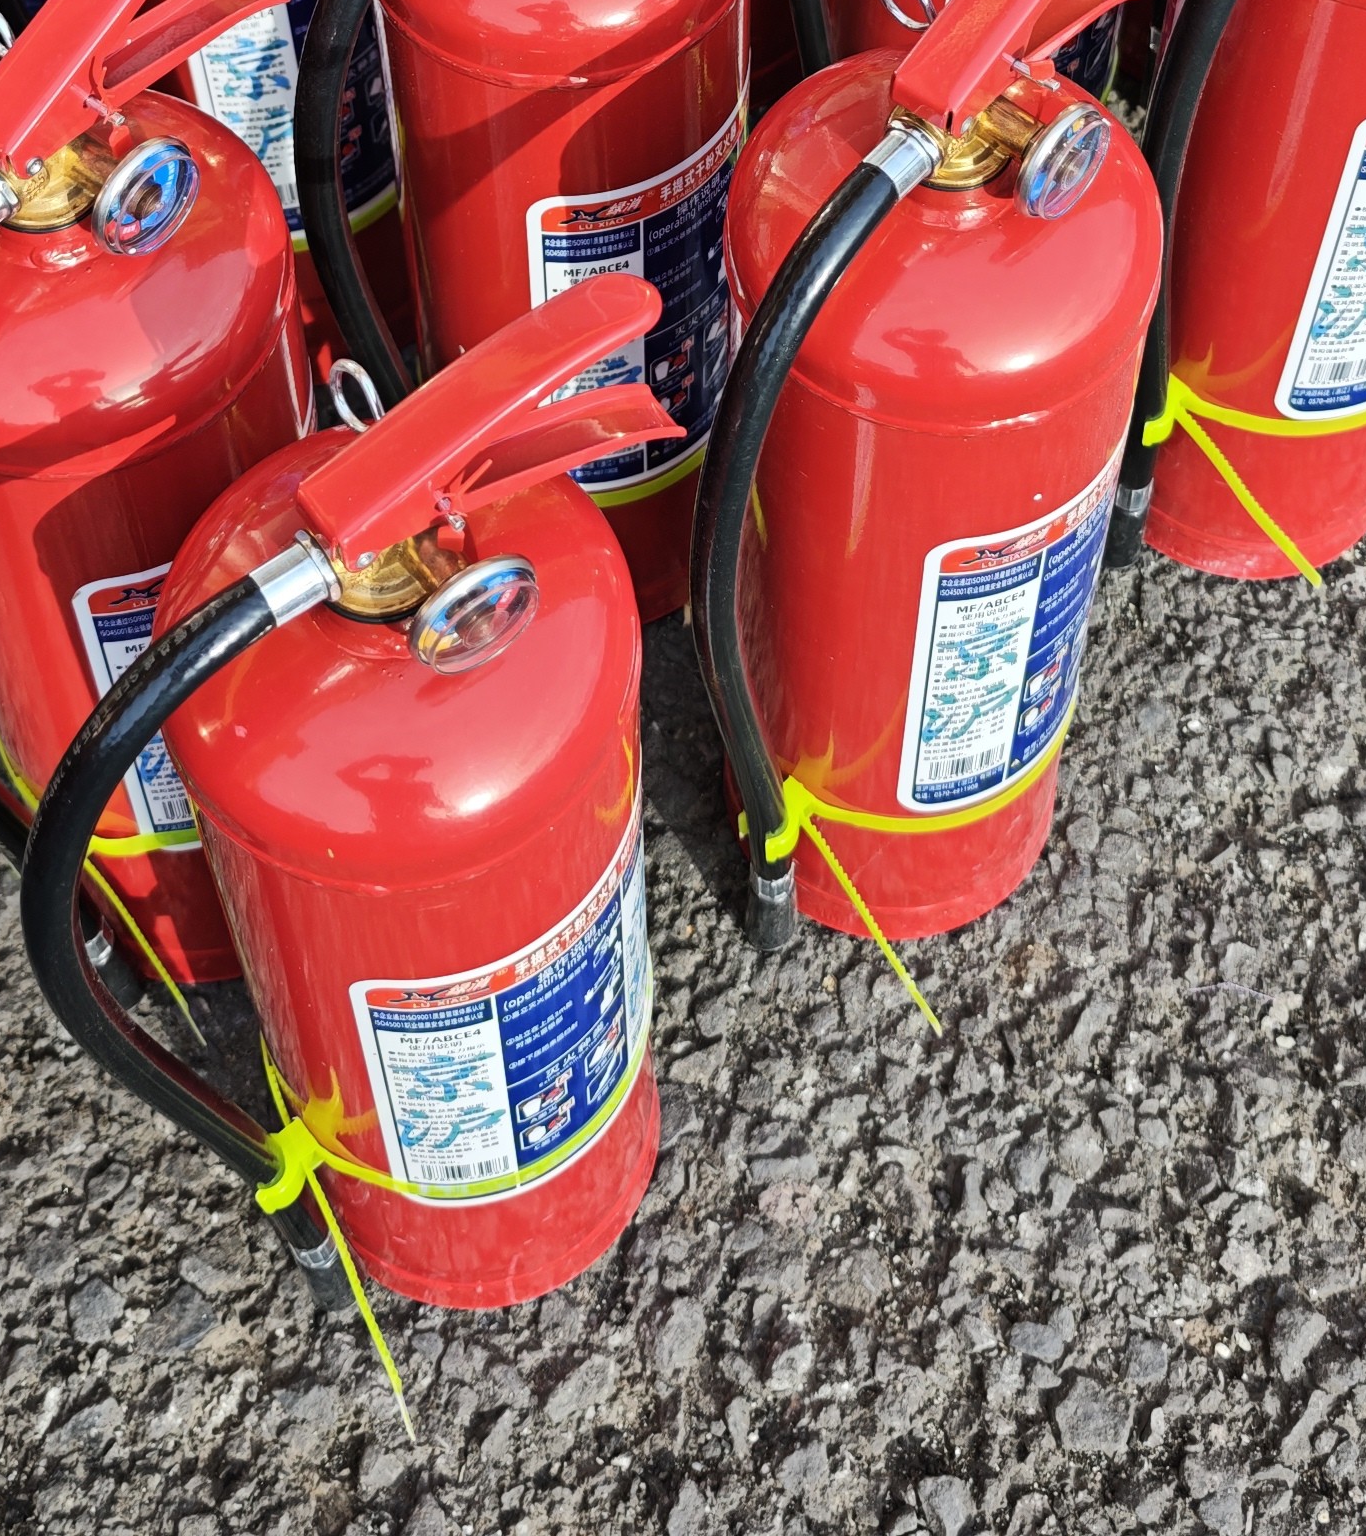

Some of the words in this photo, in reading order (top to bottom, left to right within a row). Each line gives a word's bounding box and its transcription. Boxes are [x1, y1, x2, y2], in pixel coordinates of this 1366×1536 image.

[578, 223, 593, 231] LU
[598, 217, 625, 228] XIAO
[563, 260, 630, 277] MF/ABCE4
[956, 589, 1027, 615] MF/ABCE4
[125, 642, 147, 654] MF
[503, 968, 566, 1013] (operating
[566, 900, 619, 971] instructions)
[399, 1028, 482, 1045] MF/ABCE4
